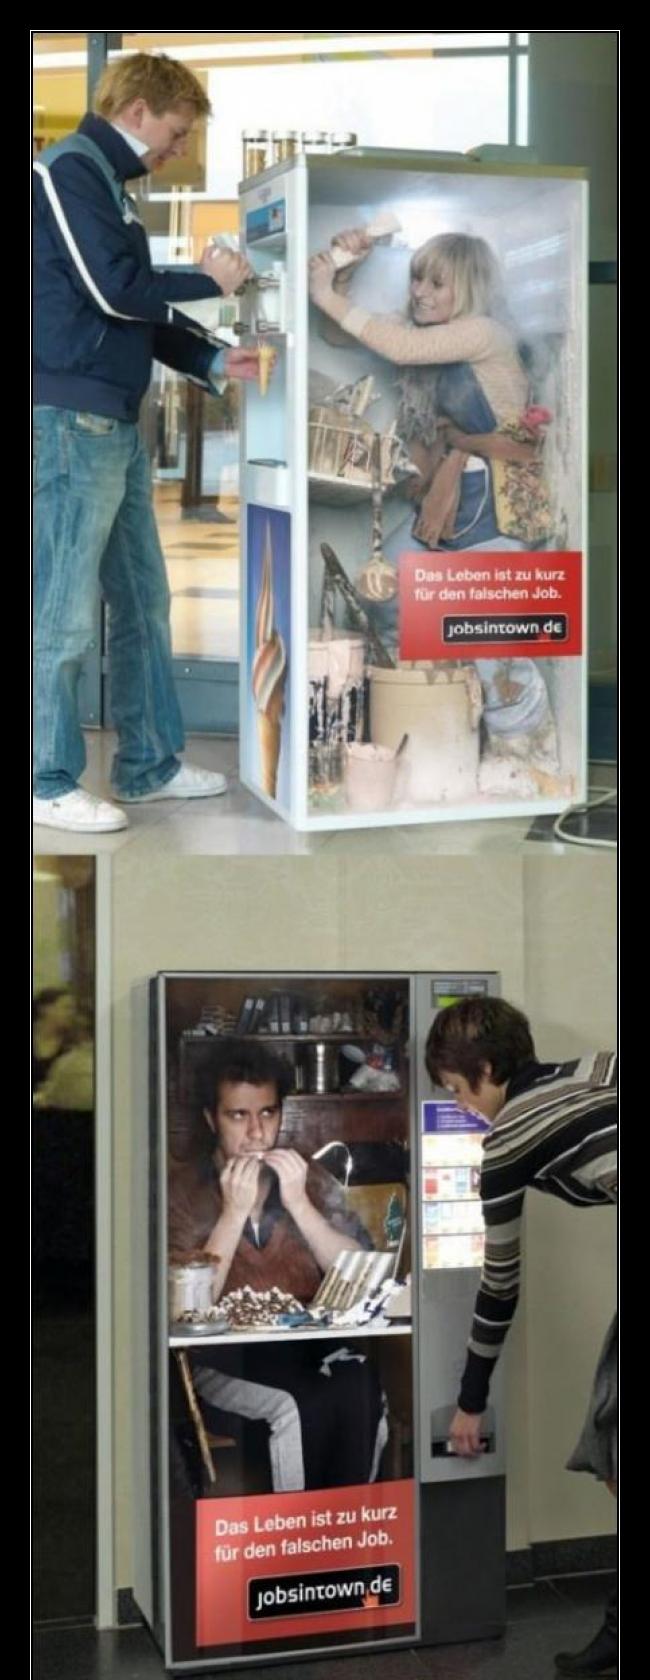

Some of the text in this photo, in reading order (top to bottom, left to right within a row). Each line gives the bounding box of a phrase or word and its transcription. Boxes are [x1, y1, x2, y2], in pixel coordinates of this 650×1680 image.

[415, 569, 566, 581] Das Leben ist zu kurz
[415, 587, 561, 601] für den falschen Job.
[215, 1506, 397, 1536] Das Leben ist zu kurz
[215, 1530, 393, 1563] für den falschen Job.
